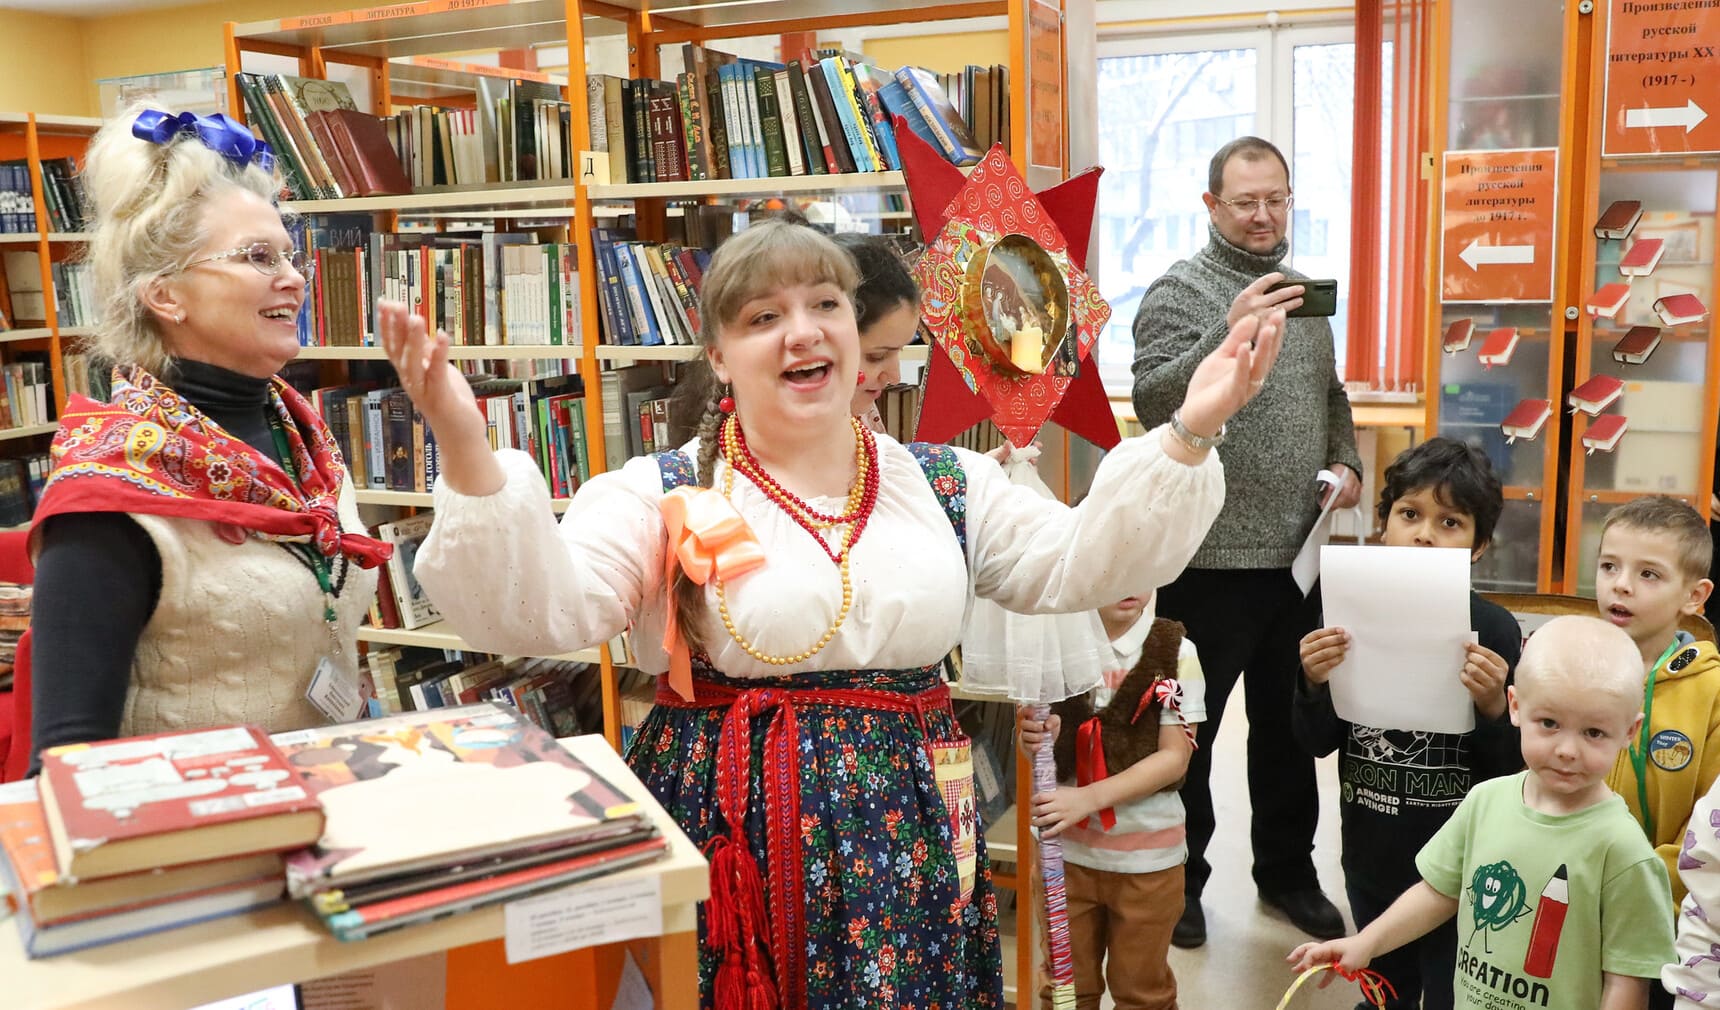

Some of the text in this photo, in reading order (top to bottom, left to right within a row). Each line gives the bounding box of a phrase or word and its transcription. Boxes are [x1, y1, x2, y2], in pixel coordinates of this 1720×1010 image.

[1622, 0, 1720, 15] Произведения
[1641, 22, 1697, 39] русской
[1642, 74, 1678, 88] (1917
[584, 157, 595, 177] Д
[1477, 180, 1524, 192] русской
[1465, 196, 1536, 207] литературы
[329, 226, 361, 248] ВИЙ
[1405, 773, 1470, 797] MAN
[1356, 787, 1400, 805] ARMORED
[1357, 797, 1399, 816] AVENGER
